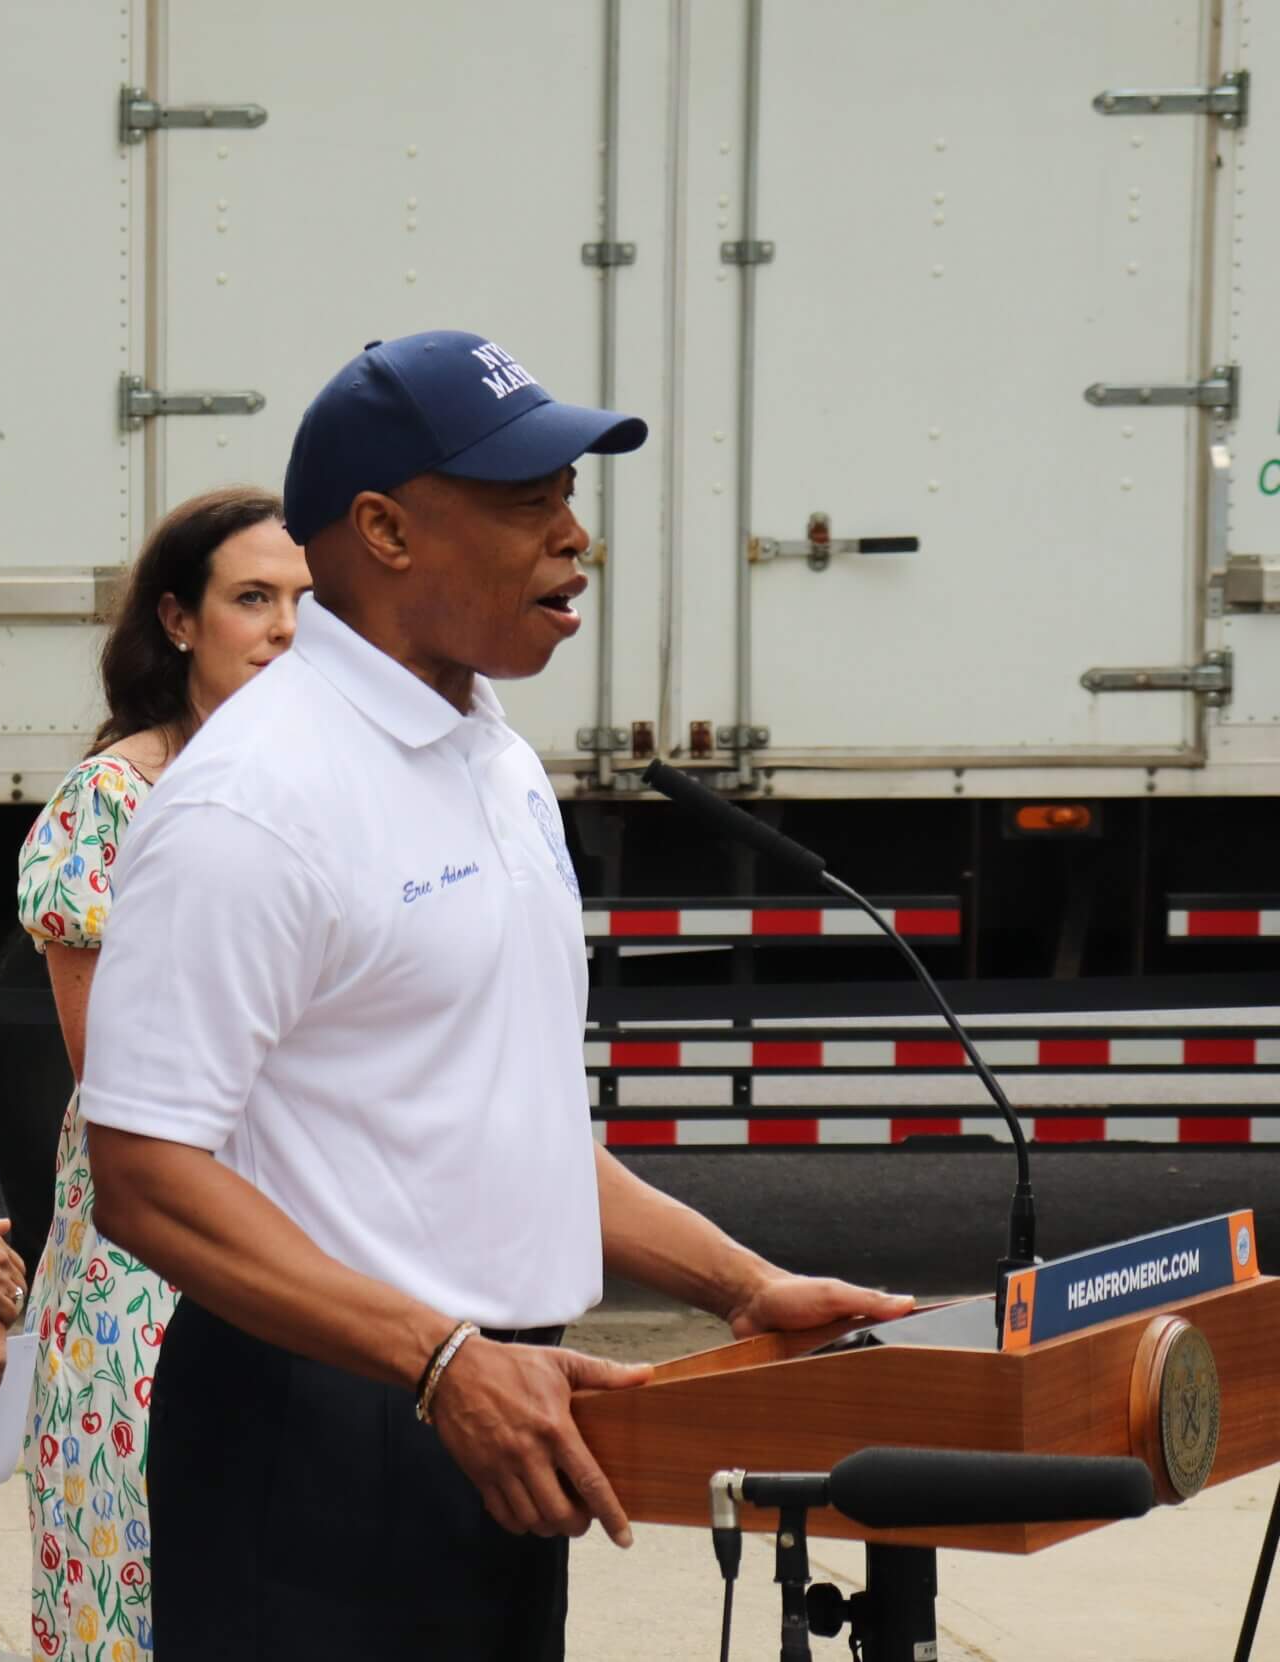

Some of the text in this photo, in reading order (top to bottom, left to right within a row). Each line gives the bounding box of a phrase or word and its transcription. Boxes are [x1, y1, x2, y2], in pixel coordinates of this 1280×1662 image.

[402, 861, 481, 905] Eric Adams
[1067, 1247, 1200, 1311] HEARFROMERIC.COM
